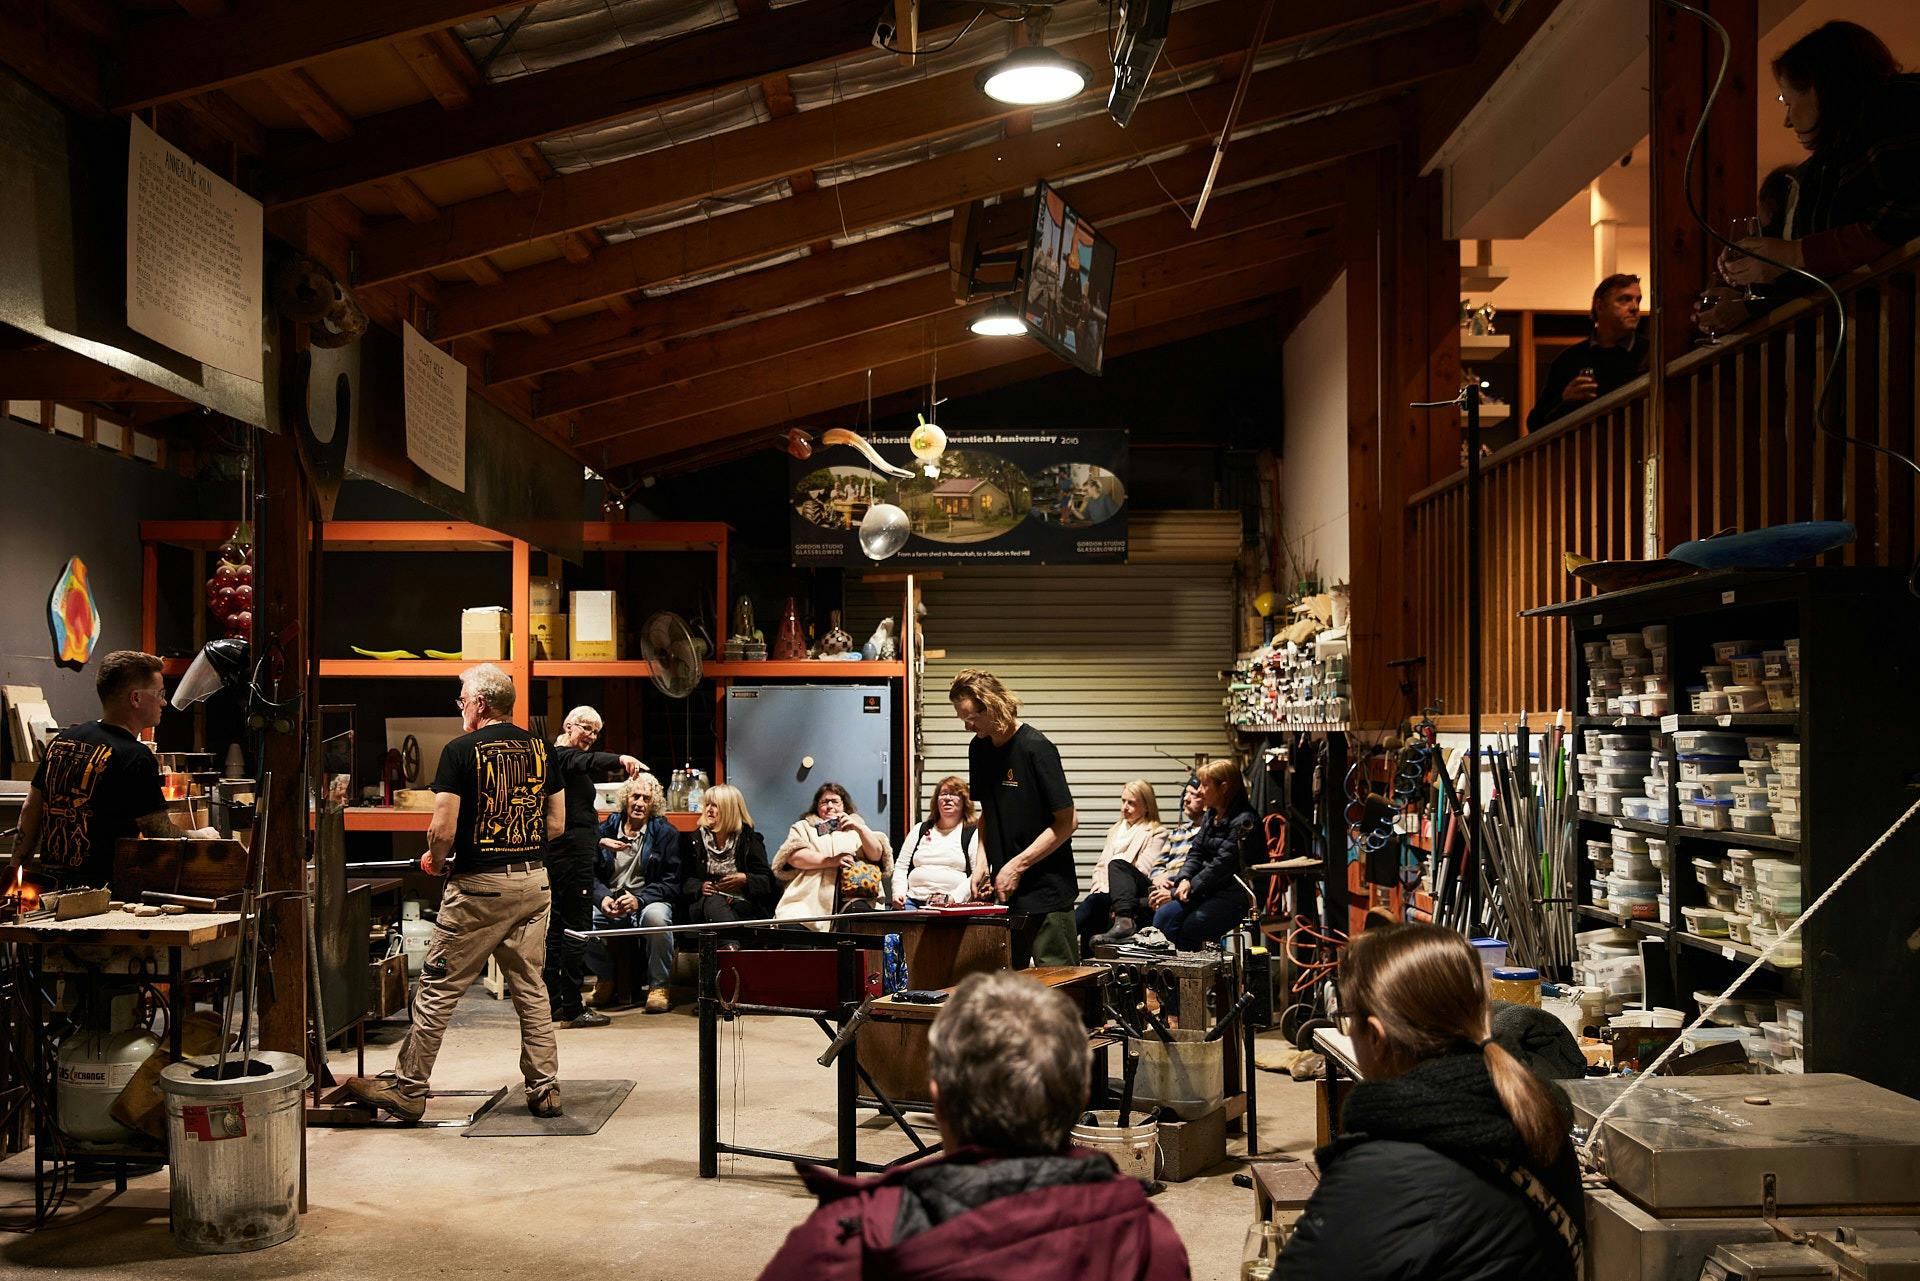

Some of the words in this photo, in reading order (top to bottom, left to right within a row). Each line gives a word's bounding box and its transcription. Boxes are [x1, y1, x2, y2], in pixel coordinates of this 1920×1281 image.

[165, 151, 198, 186] ANNEALING
[198, 177, 212, 197] KILN
[862, 436, 910, 444] elebrati
[946, 435, 994, 444] wentieth
[995, 435, 1058, 444] Anniversary
